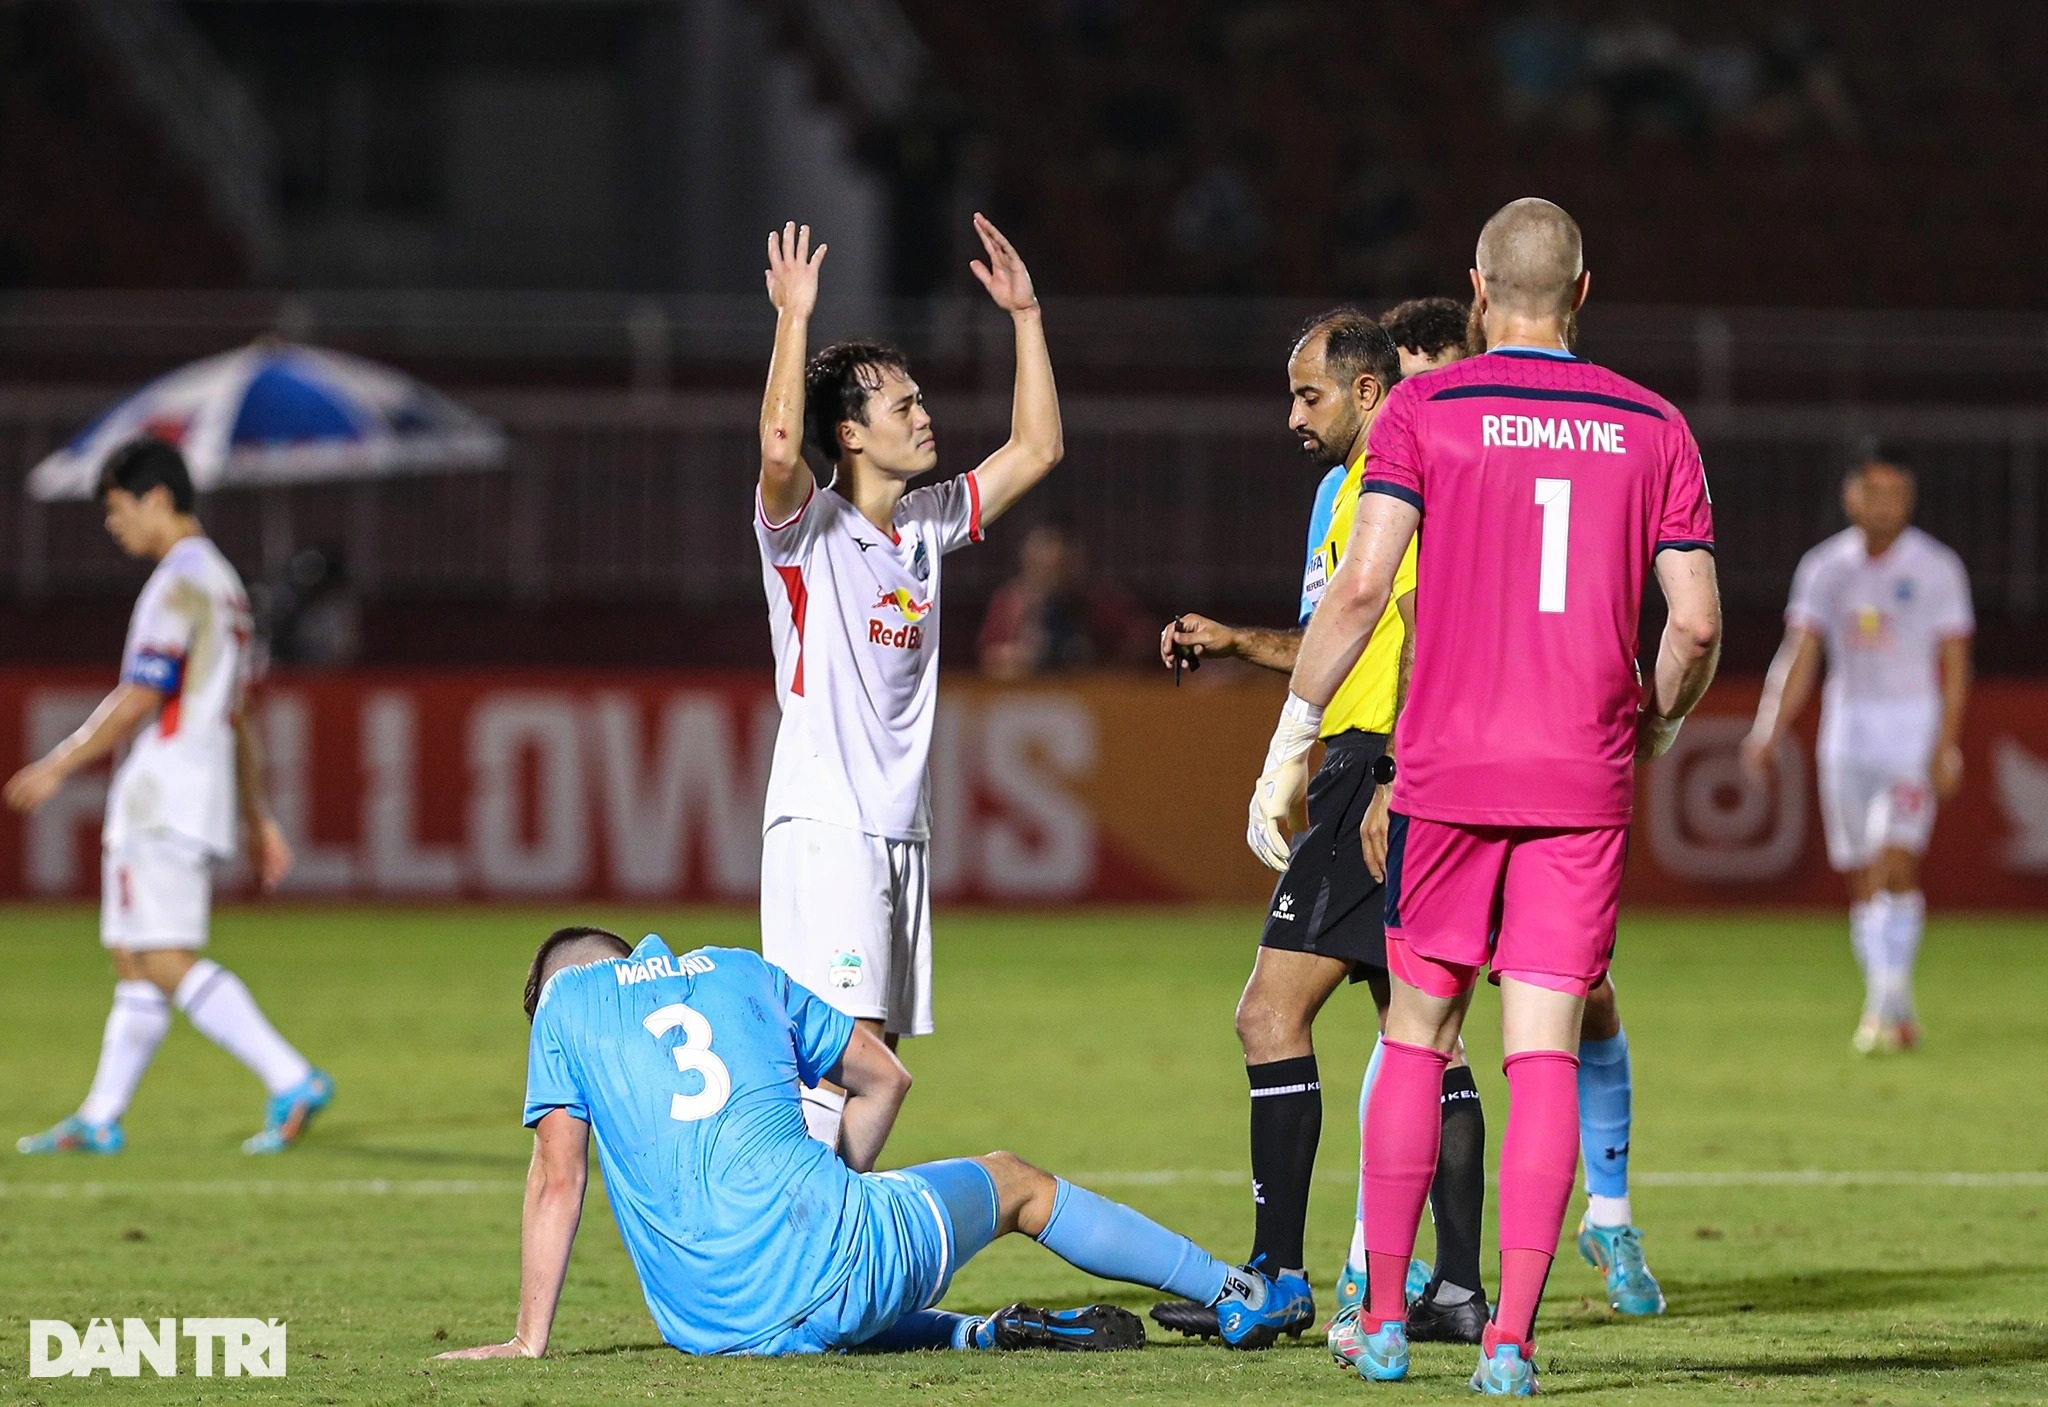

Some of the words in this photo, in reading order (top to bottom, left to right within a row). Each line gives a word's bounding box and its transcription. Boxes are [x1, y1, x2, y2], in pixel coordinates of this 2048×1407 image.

[1482, 415, 1627, 454] REDMAYNE
[1534, 478, 1571, 612] 1
[24, 692, 780, 894] FLLOW
[642, 1002, 731, 1121] 3
